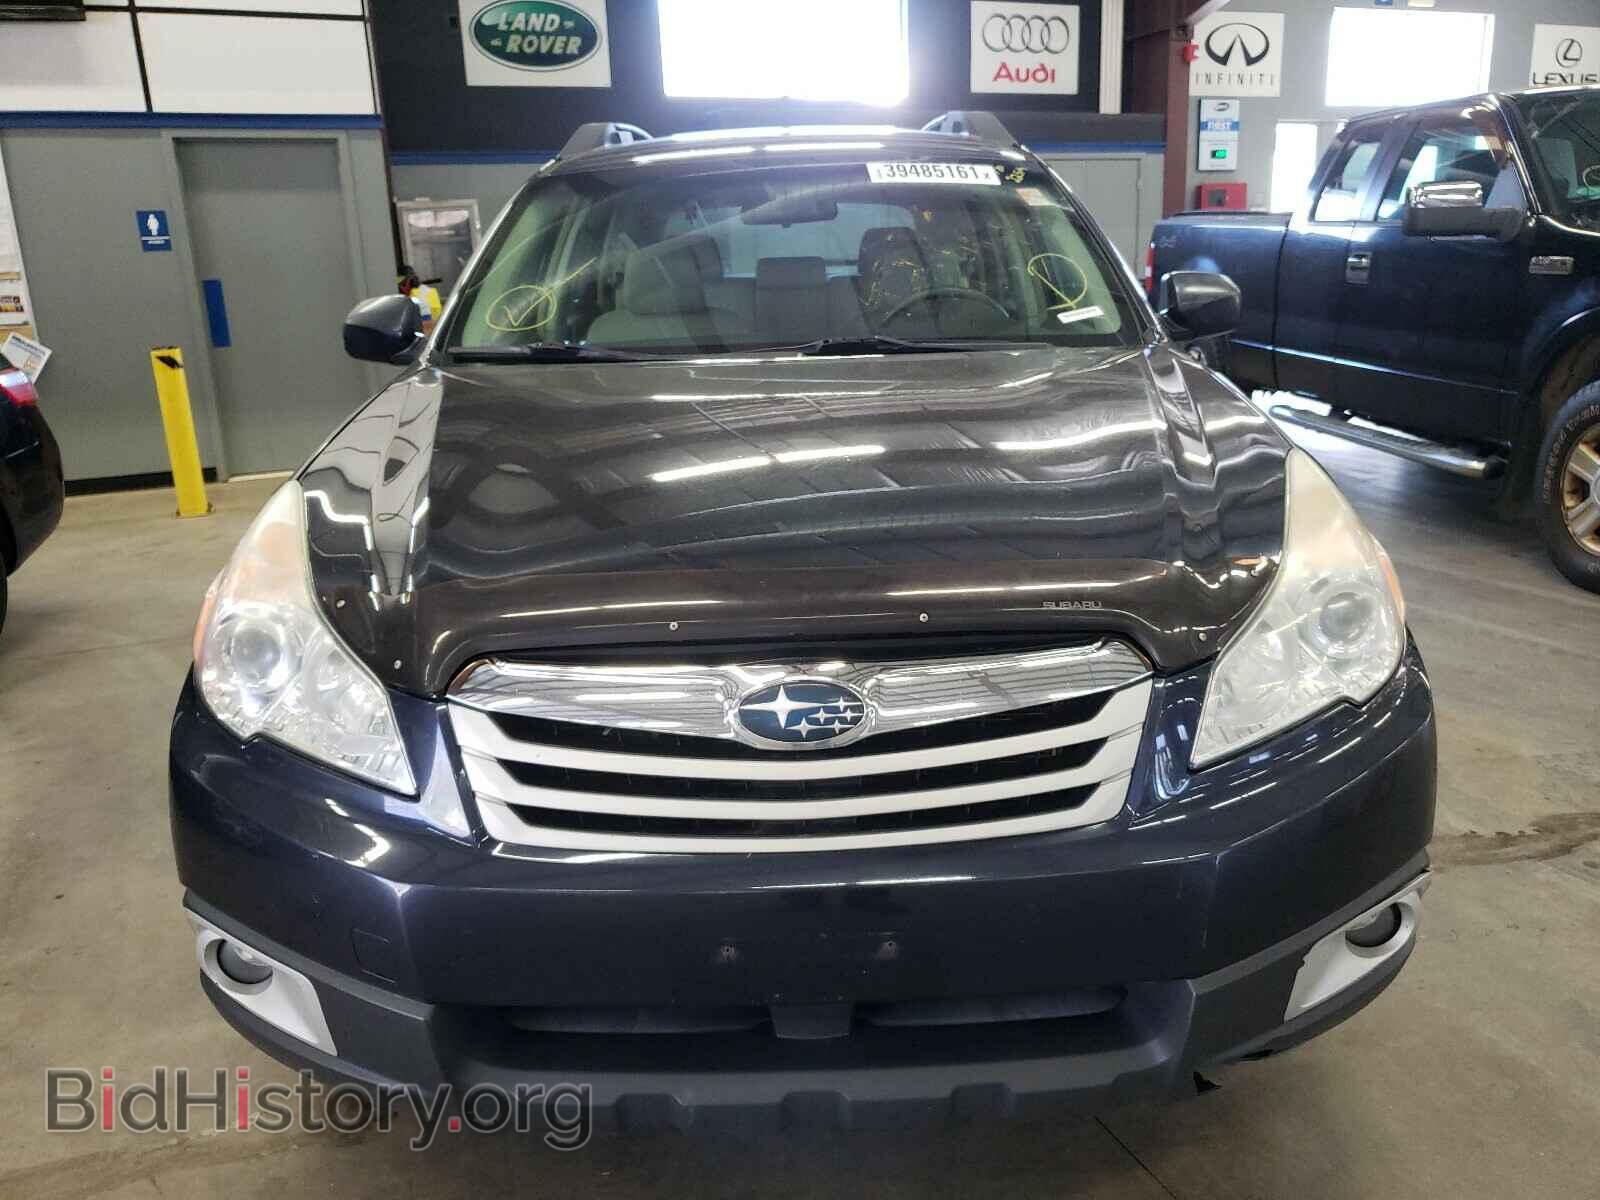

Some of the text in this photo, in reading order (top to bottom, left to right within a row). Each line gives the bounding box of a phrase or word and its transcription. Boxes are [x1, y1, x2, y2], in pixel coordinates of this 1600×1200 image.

[497, 12, 560, 31] LAND
[505, 35, 582, 54] ROVER
[992, 62, 1056, 83] Audi
[1195, 71, 1275, 86] INFINITI
[1532, 71, 1598, 85] LEXUS
[884, 163, 979, 180] 39485161
[1042, 601, 1102, 609] SUBARU
